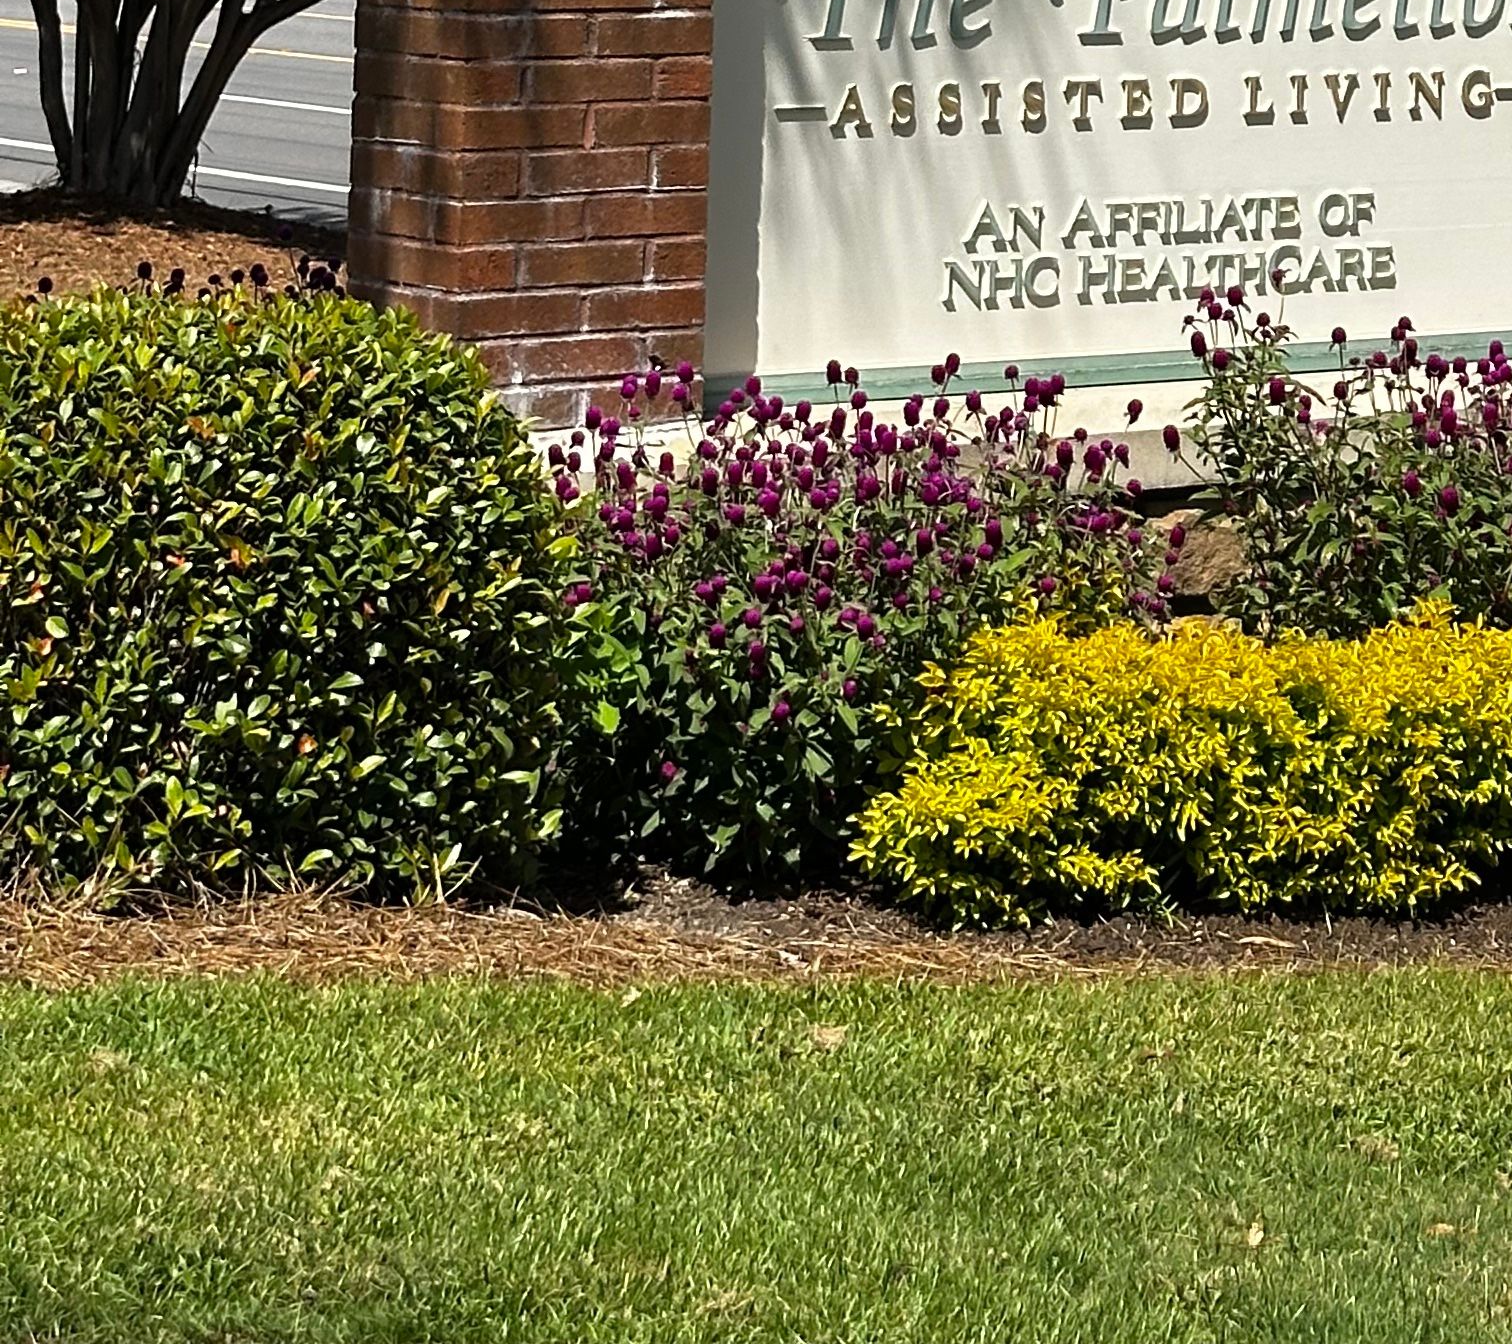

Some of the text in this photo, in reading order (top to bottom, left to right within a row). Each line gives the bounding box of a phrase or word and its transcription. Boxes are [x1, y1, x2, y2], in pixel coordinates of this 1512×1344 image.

[962, 192, 1377, 254] AN AFFILIATE OF
[941, 244, 1398, 313] NHC HEALTHCARE
